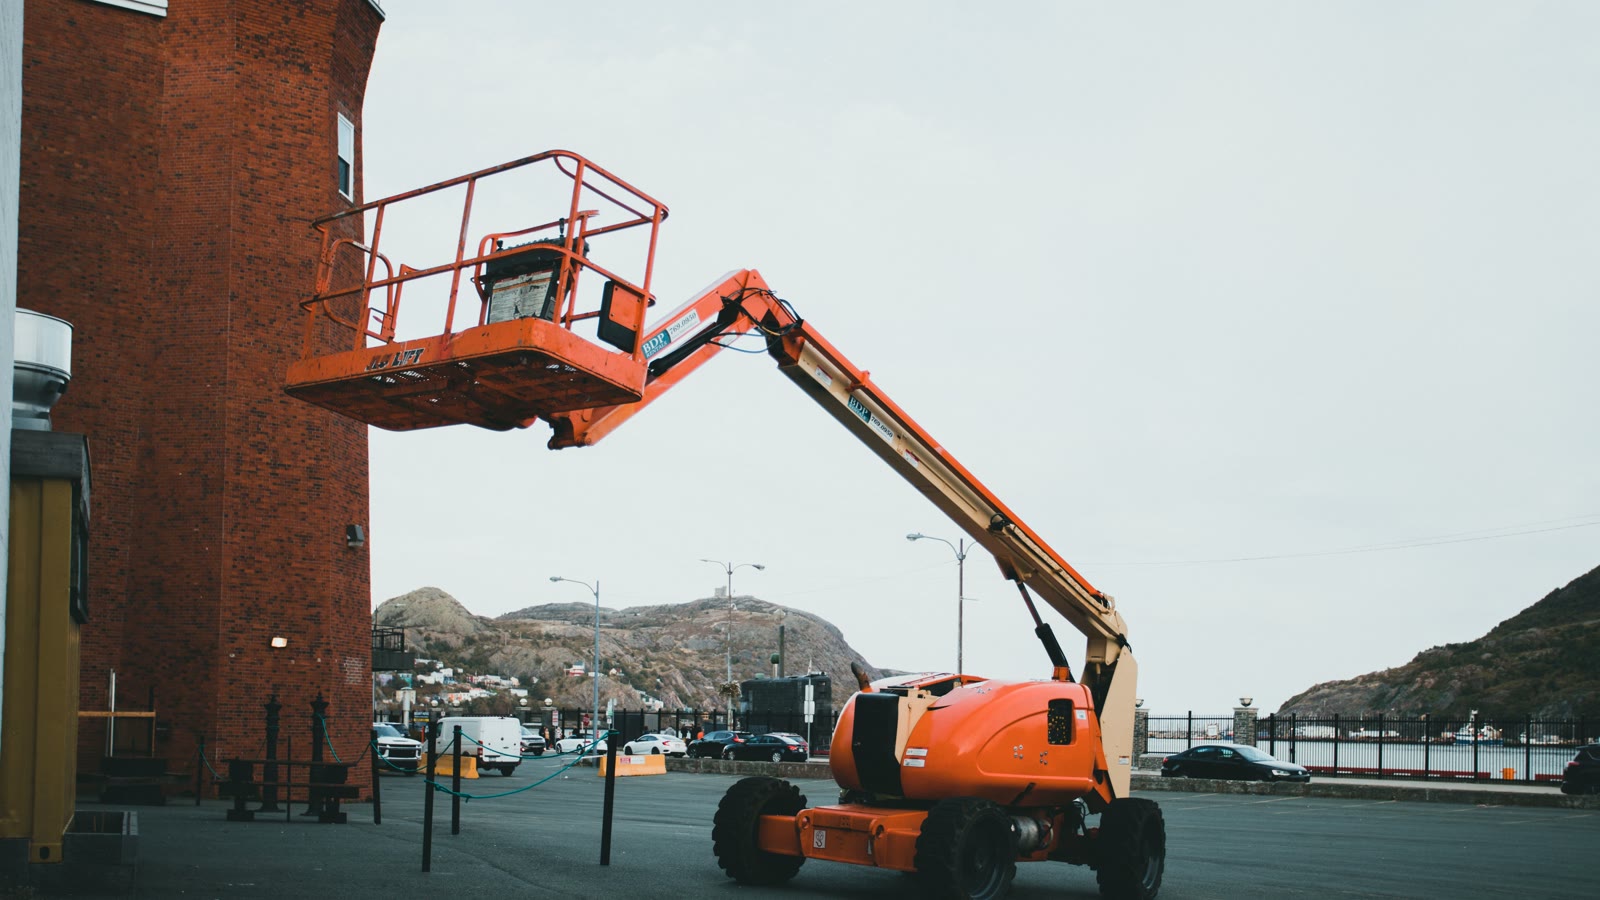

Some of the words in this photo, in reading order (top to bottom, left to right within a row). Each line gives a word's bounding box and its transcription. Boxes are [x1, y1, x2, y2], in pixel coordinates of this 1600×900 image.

[642, 332, 665, 353] BDP
[391, 348, 425, 367] LIFT
[849, 397, 868, 415] BDP
